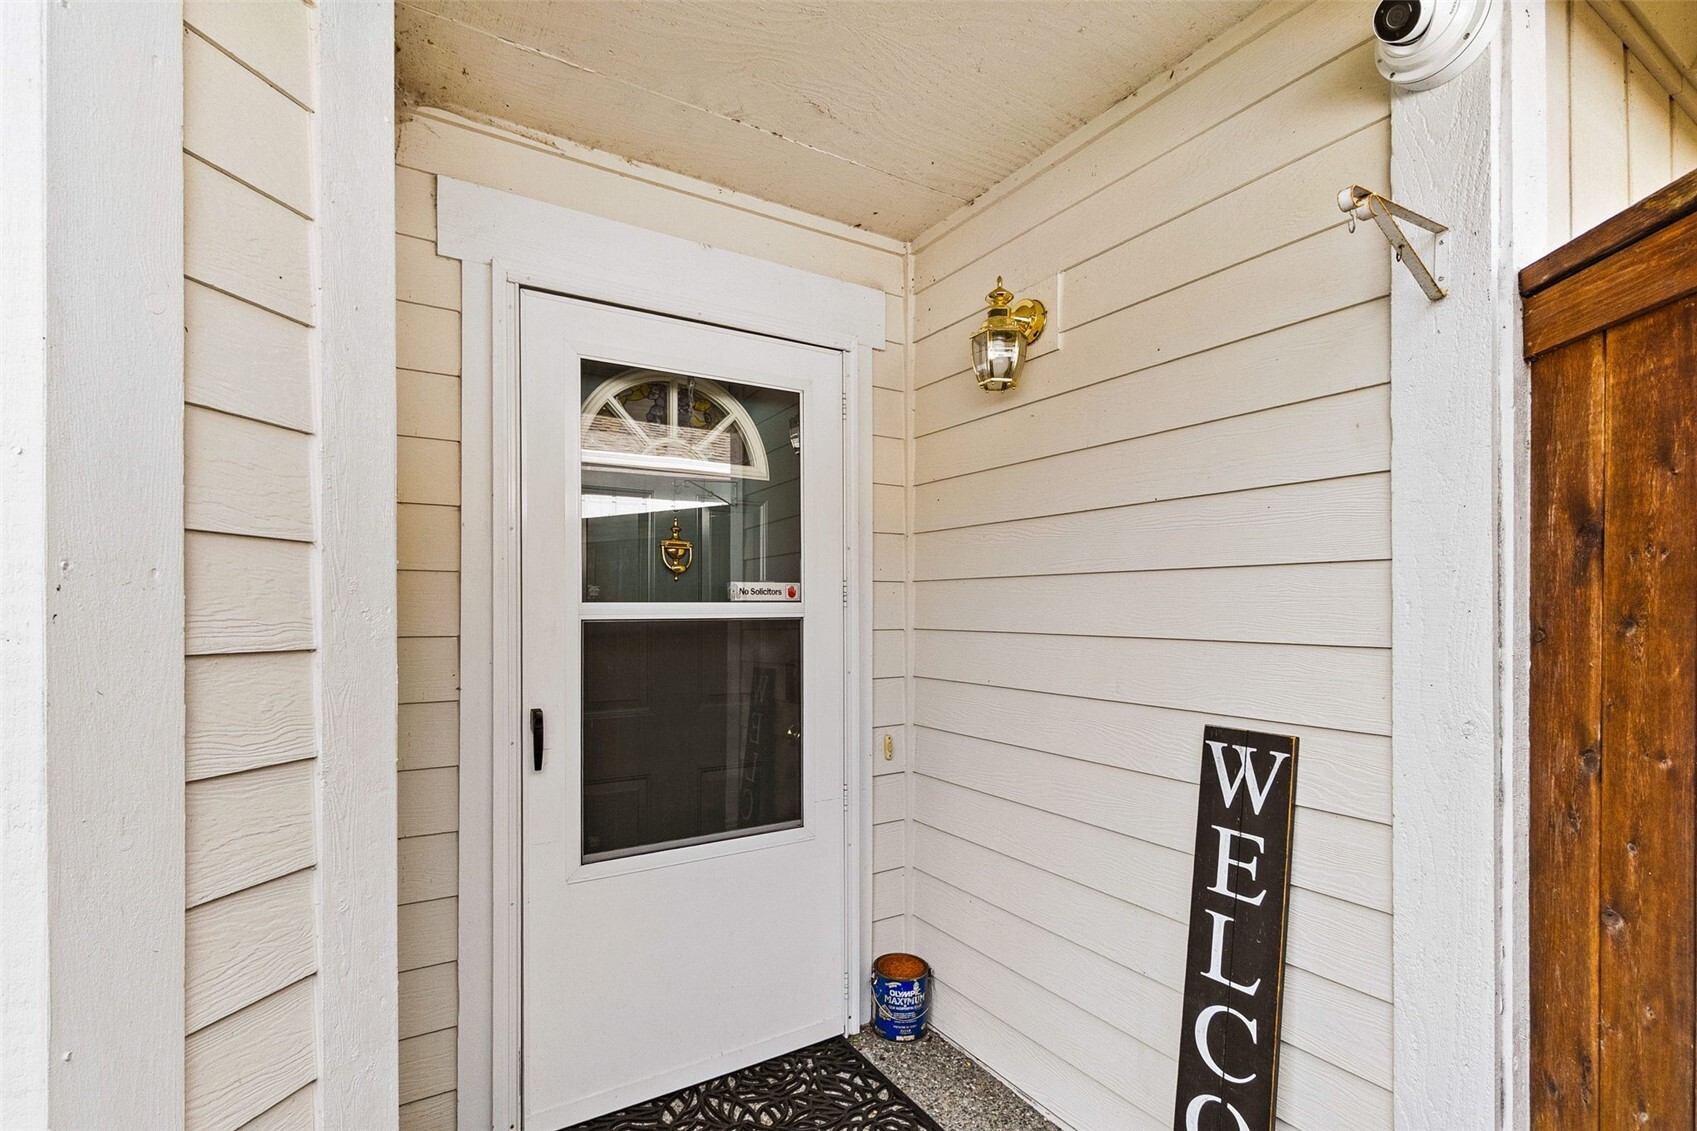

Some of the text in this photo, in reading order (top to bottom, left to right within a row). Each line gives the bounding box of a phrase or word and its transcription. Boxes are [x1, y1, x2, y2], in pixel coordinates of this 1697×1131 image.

[739, 587, 782, 596] No Solicitors
[884, 992, 925, 1006] MAXIMUM
